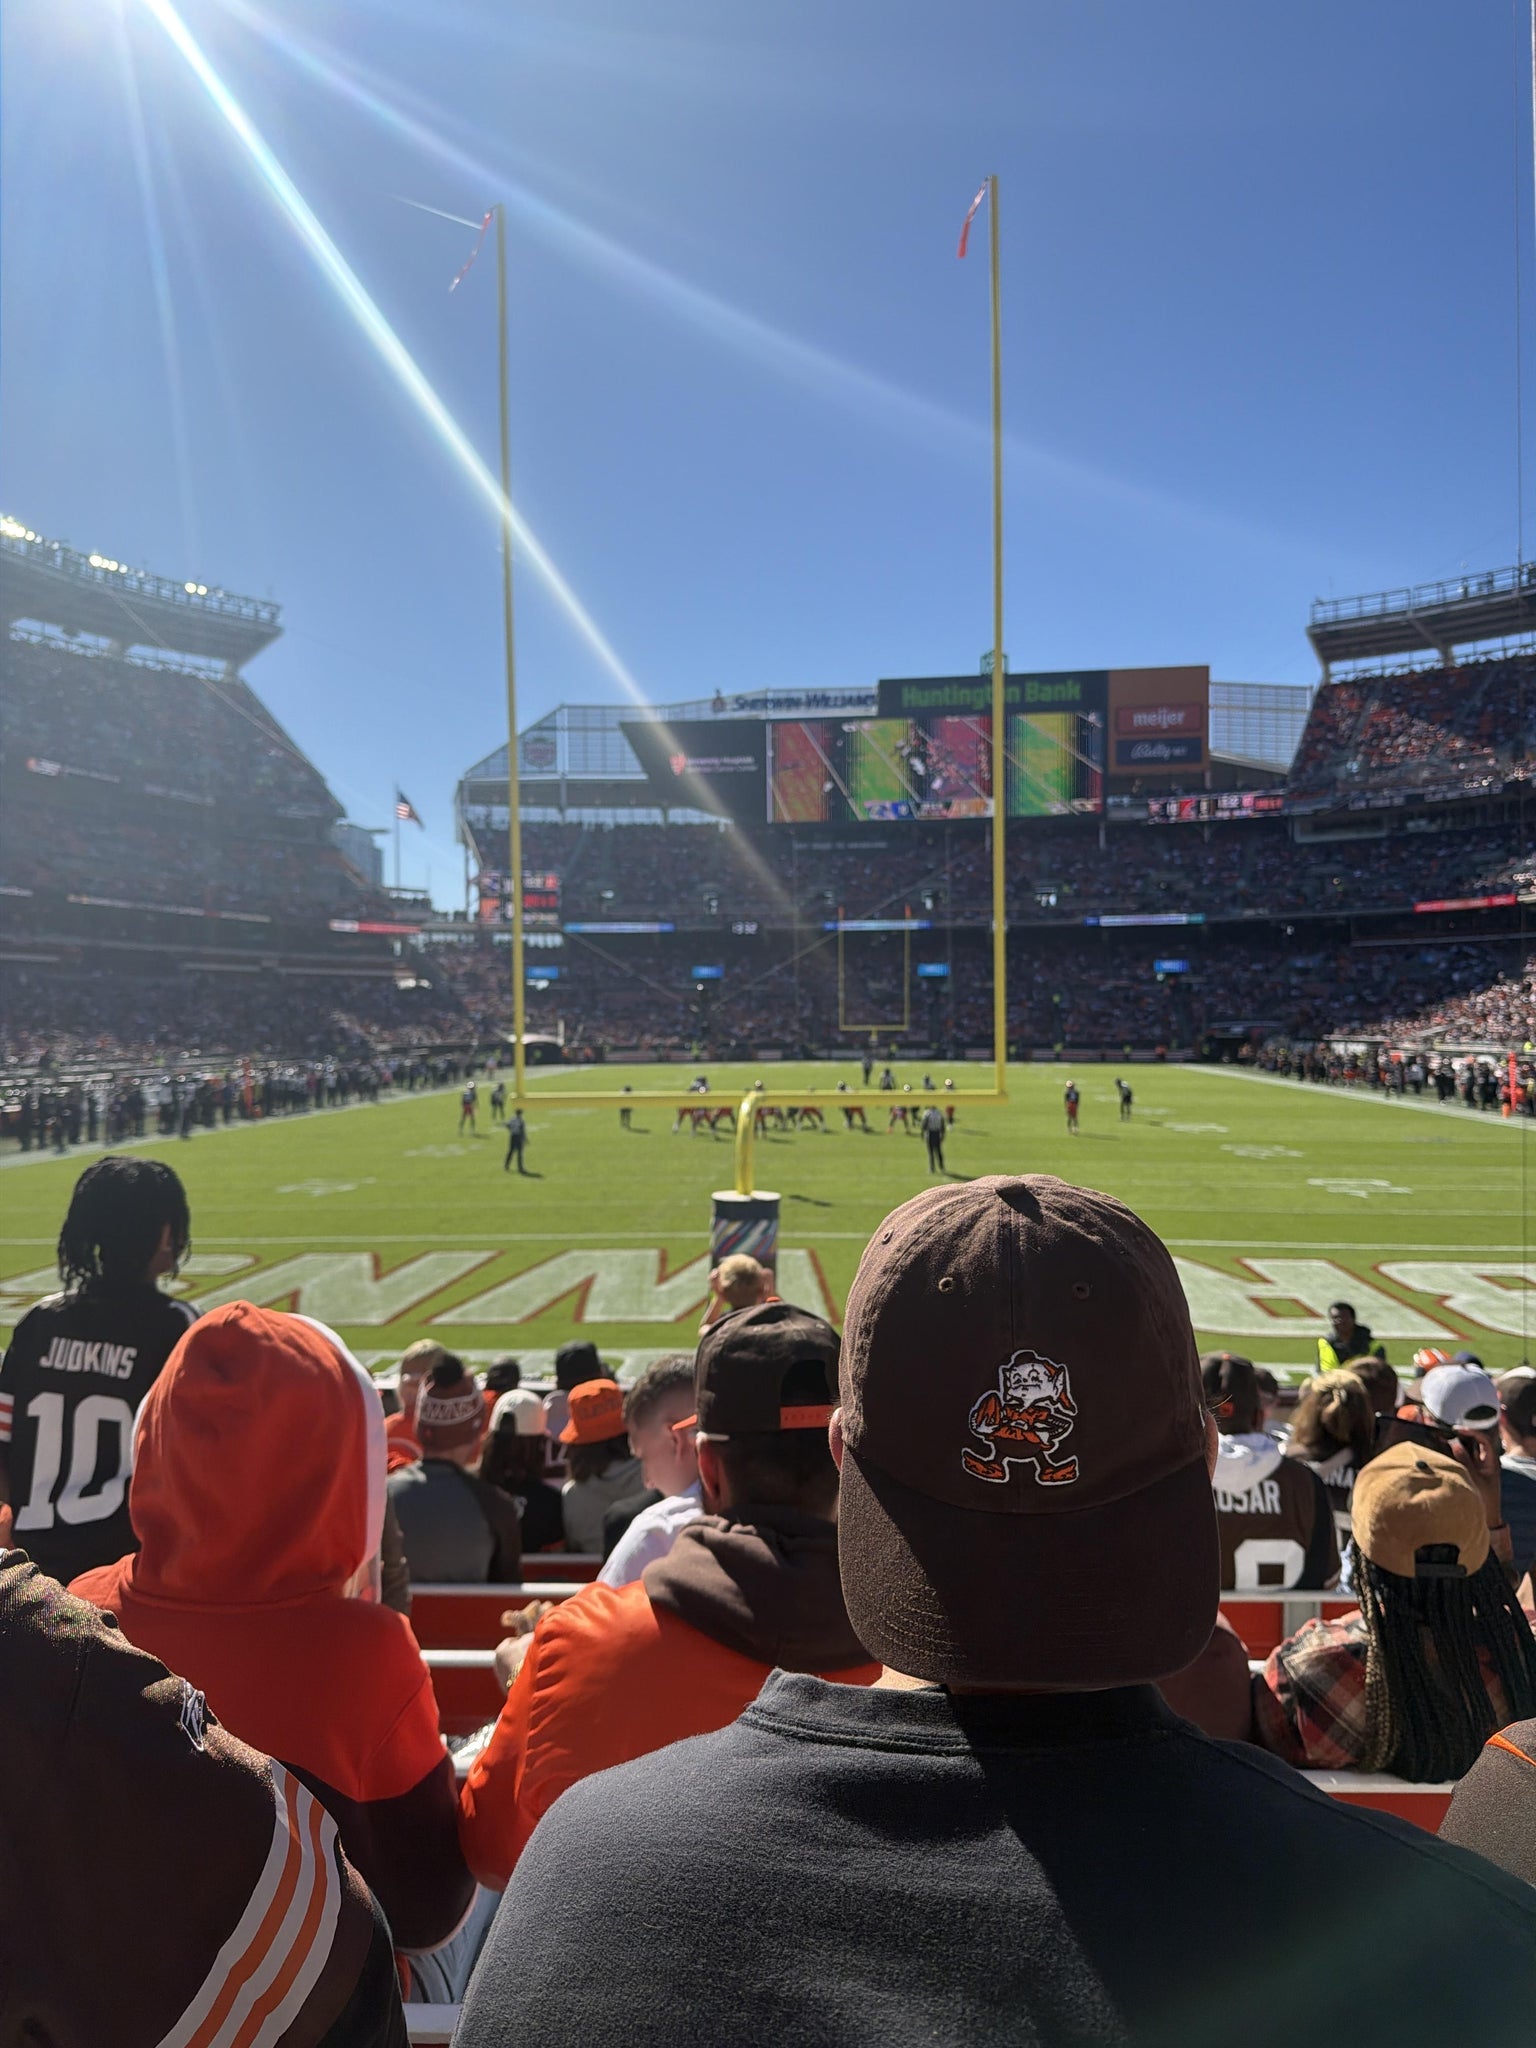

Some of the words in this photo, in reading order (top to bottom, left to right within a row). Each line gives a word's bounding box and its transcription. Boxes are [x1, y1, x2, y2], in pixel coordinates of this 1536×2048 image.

[902, 682, 1021, 710] Huntingtn
[1025, 678, 1082, 701] Bank
[1133, 706, 1185, 729] meijer
[39, 1336, 138, 1380] JUDKINS
[14, 1391, 134, 1531] 10
[1214, 1479, 1282, 1514] OSAR
